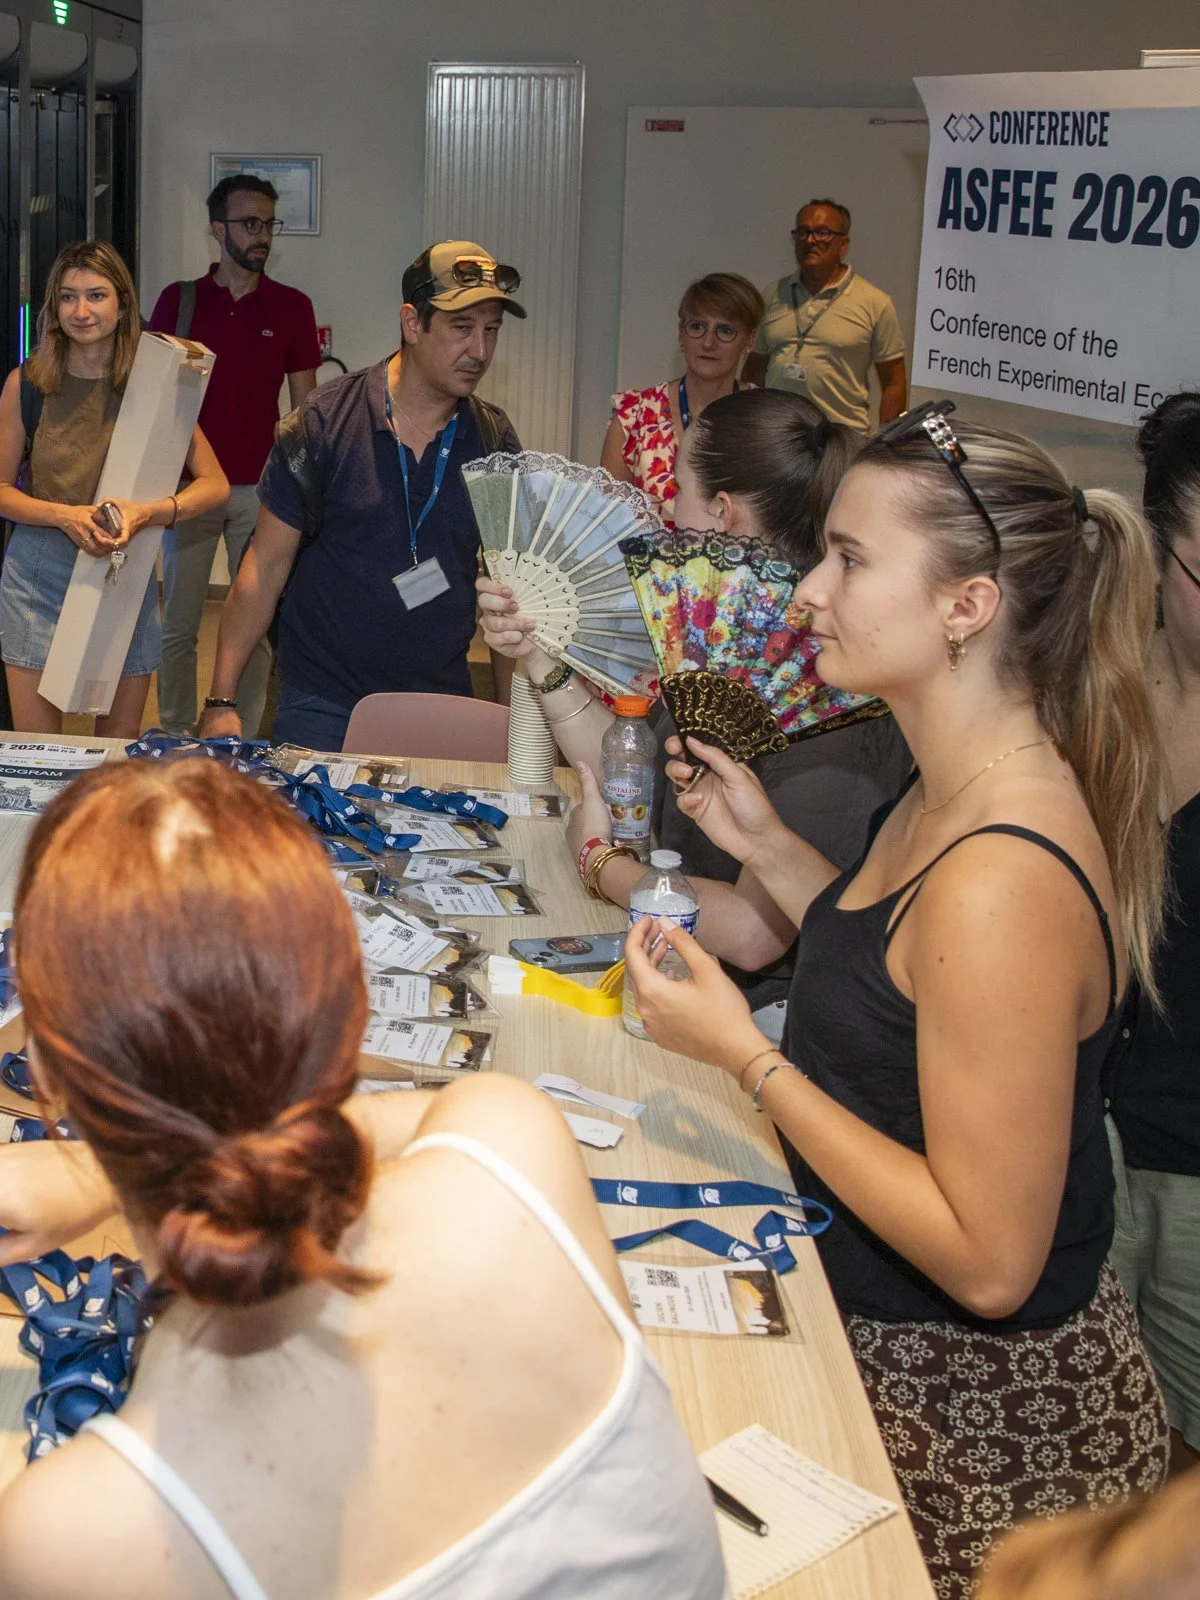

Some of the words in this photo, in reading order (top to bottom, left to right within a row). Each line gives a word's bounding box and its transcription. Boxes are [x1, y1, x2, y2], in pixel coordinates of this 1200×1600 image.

[989, 110, 1110, 147] CONFERENCE
[937, 166, 1058, 239] ASFEE
[1067, 172, 1200, 249] 2026
[934, 265, 976, 293] 16th
[930, 308, 1047, 347] Conference
[1053, 327, 1077, 352] of
[1082, 330, 1118, 358] the
[928, 349, 991, 379] French
[997, 360, 1126, 404] Experimental
[1133, 382, 1174, 411] Ec
[603, 785, 642, 794] RISTALINE
